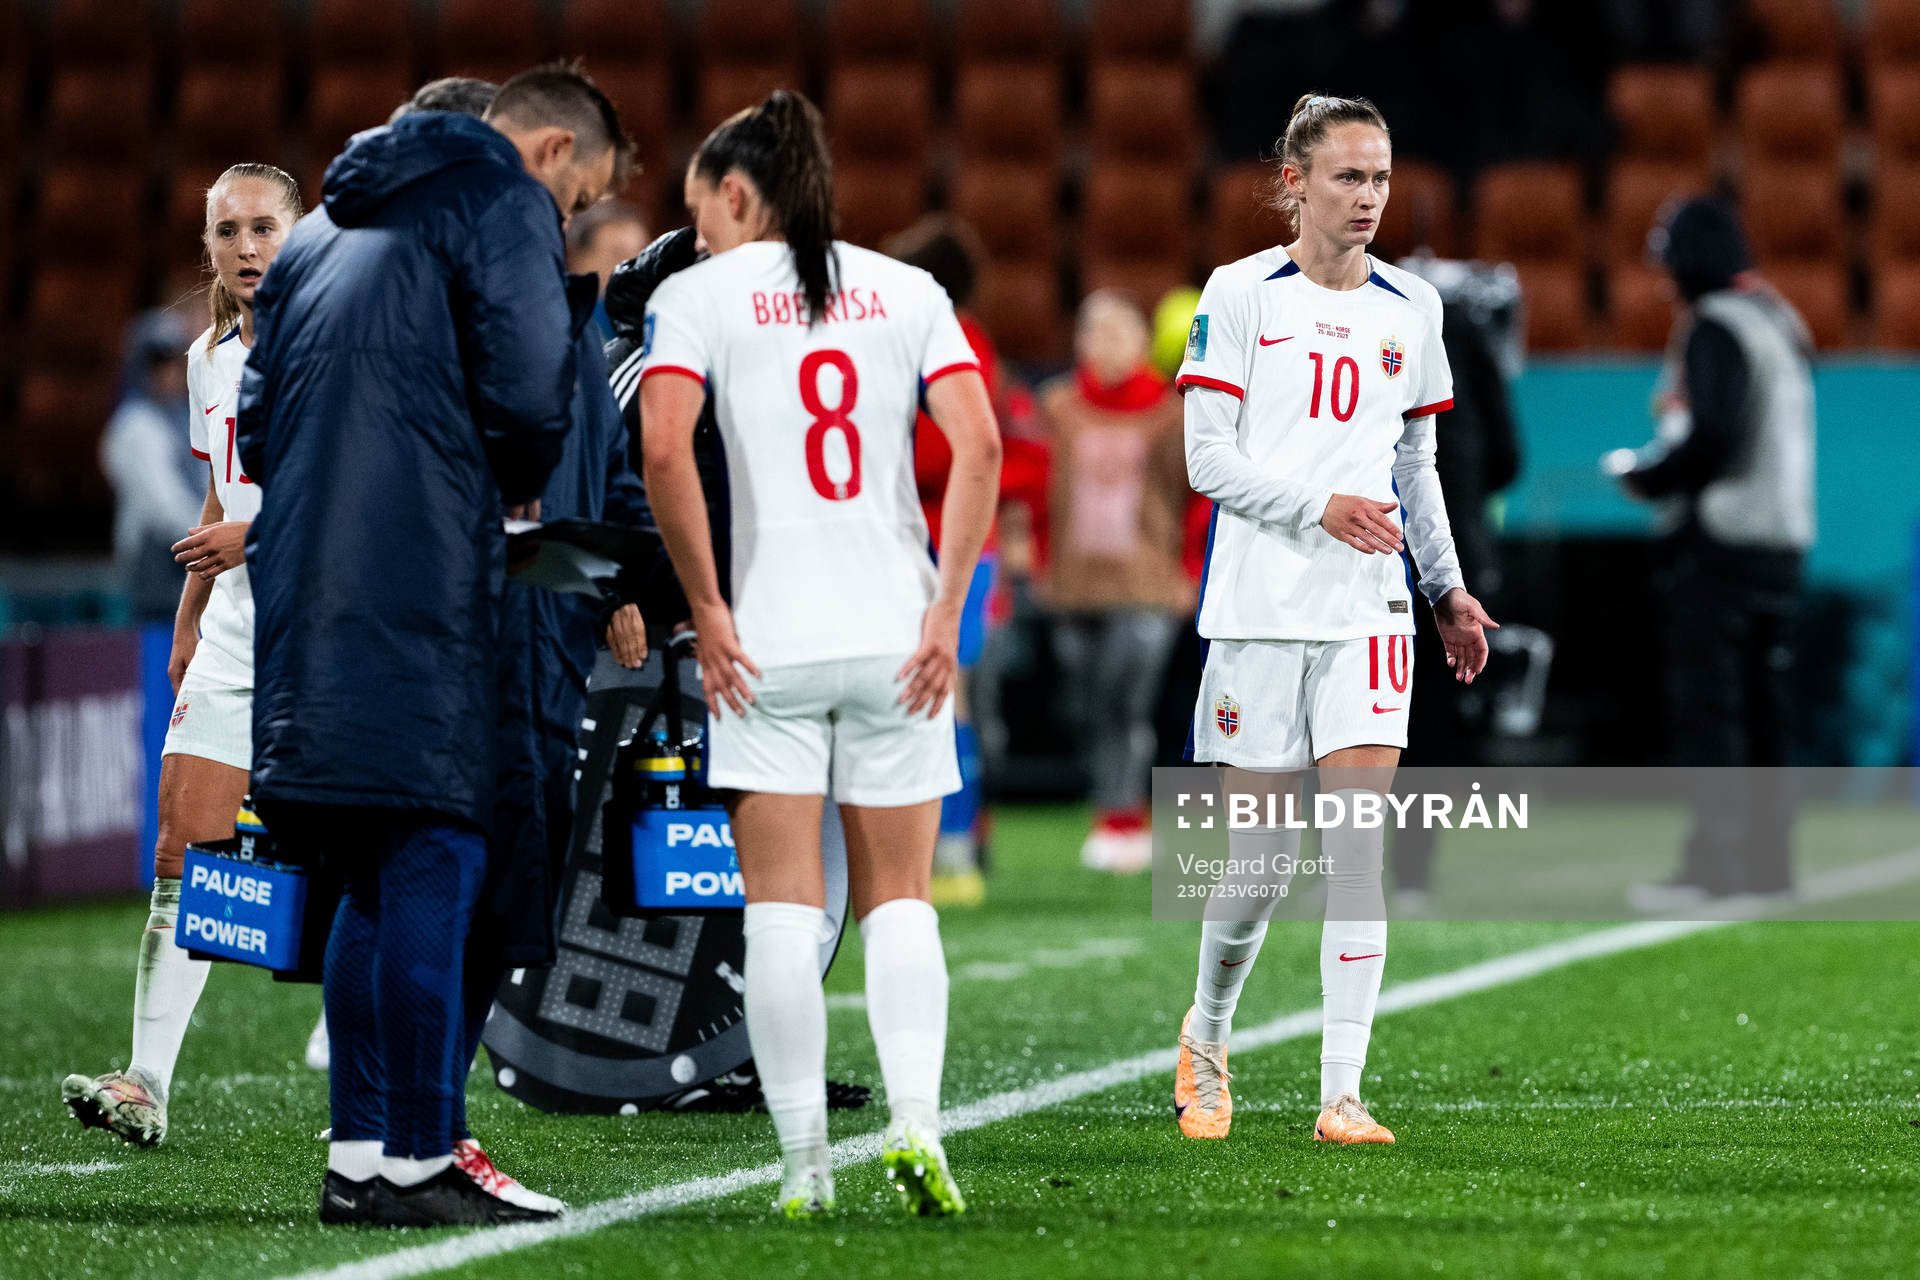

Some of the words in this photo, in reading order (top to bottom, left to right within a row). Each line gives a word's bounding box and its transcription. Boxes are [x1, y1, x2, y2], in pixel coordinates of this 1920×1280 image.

[1308, 352, 1360, 422] 10
[798, 348, 861, 501] 8
[1368, 634, 1408, 694] 10
[191, 864, 273, 906] PAUSE
[185, 912, 267, 955] POWER
